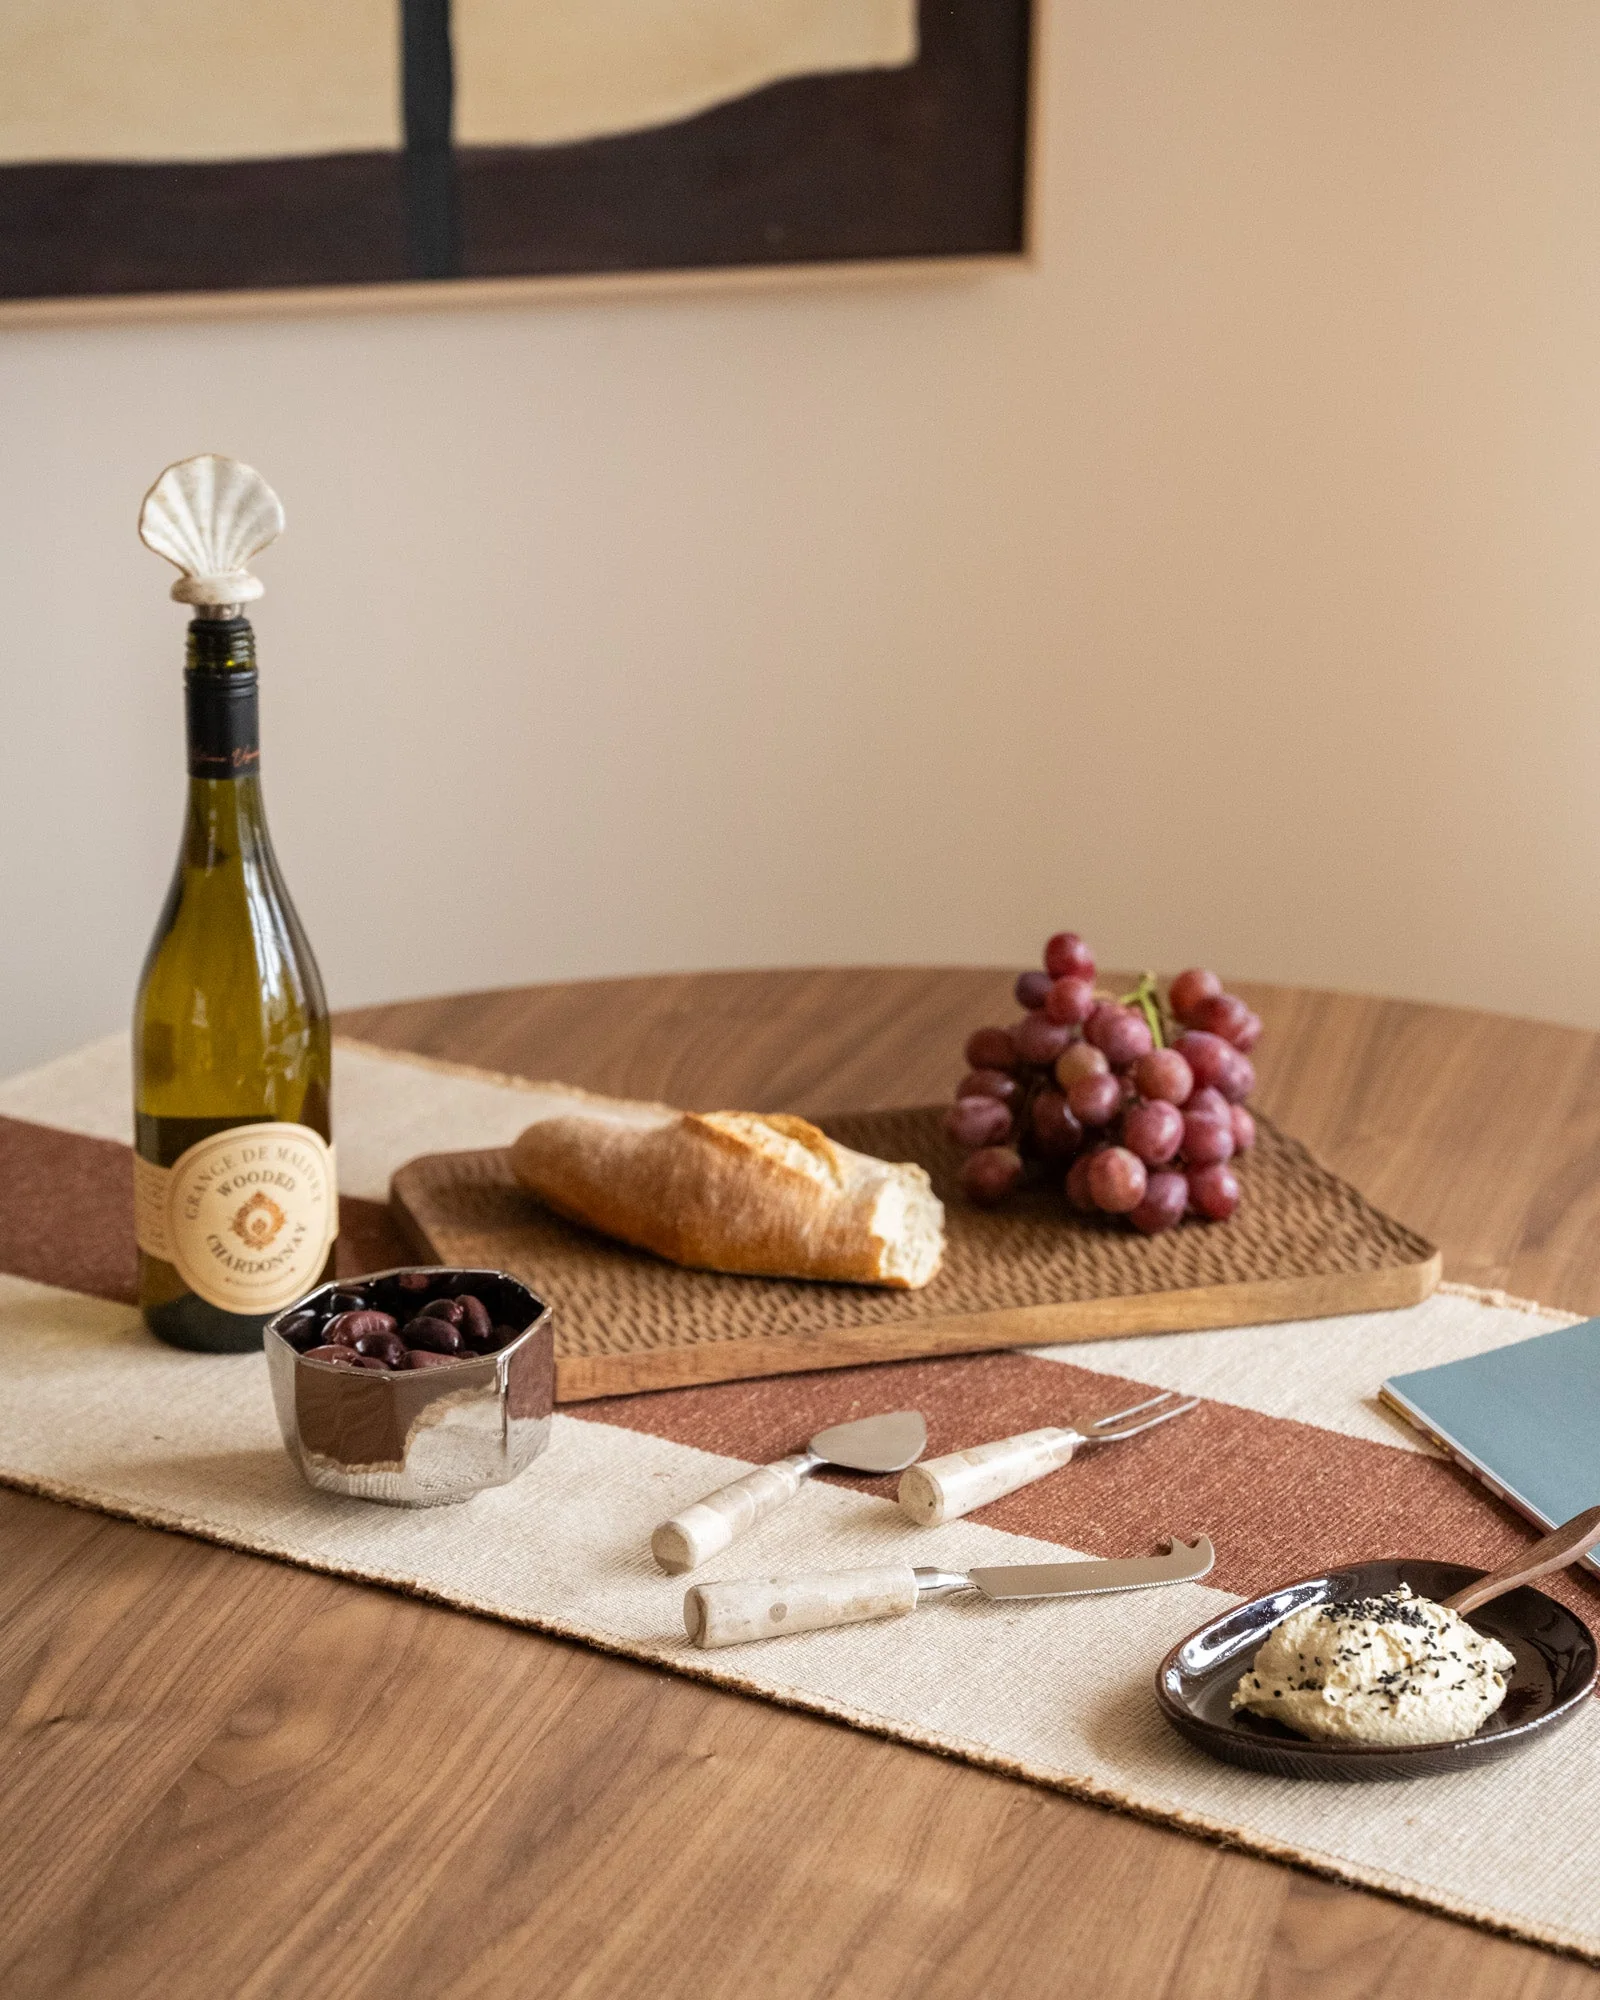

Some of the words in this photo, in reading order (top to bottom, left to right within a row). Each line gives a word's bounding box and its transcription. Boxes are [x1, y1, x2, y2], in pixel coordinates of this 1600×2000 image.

[184, 1156, 236, 1221] GRANGE
[242, 1146, 269, 1162] DE
[217, 1170, 296, 1197] WOODED
[206, 1222, 307, 1274] CHARDONNAY
